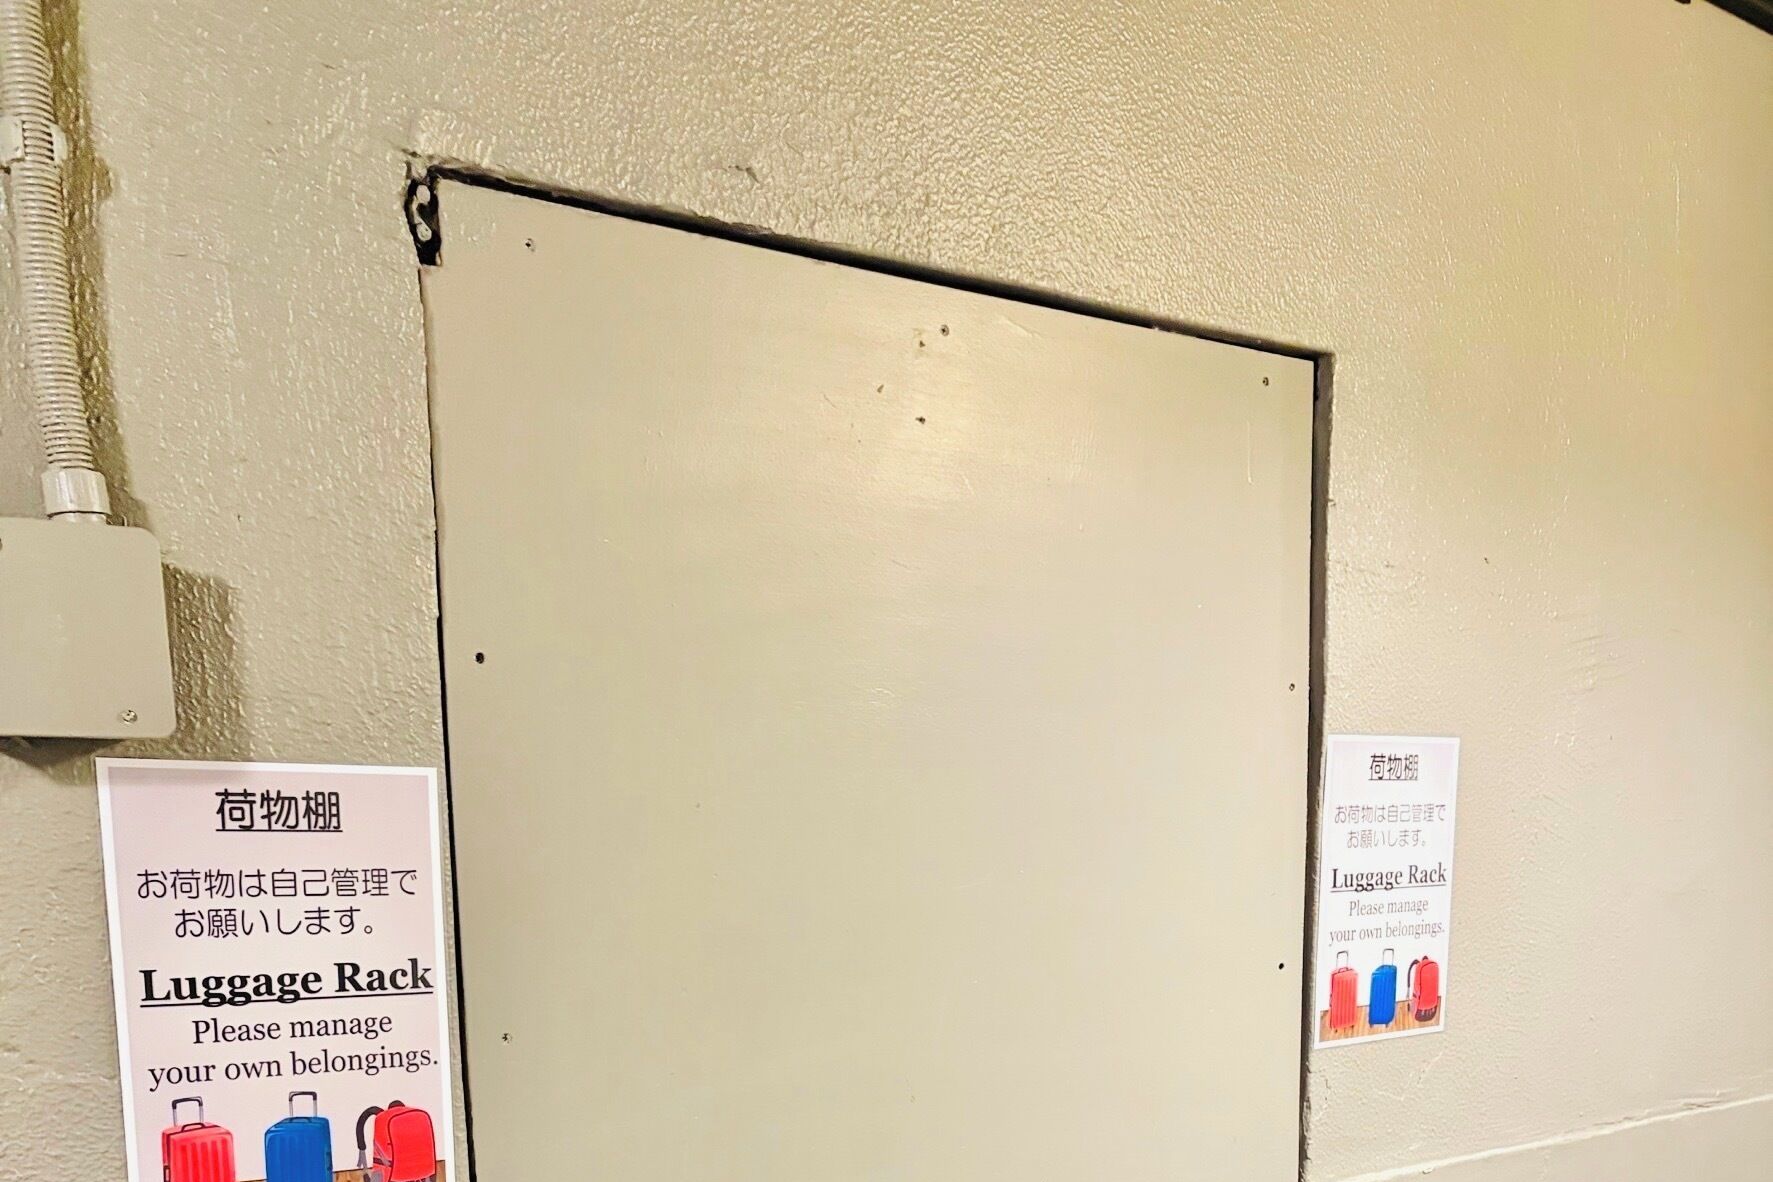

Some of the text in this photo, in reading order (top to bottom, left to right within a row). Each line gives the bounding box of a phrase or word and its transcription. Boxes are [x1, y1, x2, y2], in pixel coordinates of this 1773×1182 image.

[1369, 753, 1418, 780] 荷物棚
[215, 789, 340, 831] 荷物棚
[1335, 804, 1445, 824] お荷物は自己管理で
[1347, 829, 1426, 848] お願いします。
[137, 868, 418, 900] お荷物は自己管理で
[1331, 862, 1447, 891] Luggage Rack
[1349, 899, 1429, 916] Please manage
[175, 908, 373, 939] お願いします。
[1329, 920, 1445, 946] your own belongings.
[140, 959, 433, 1007] Luggage Rack
[192, 1015, 392, 1044] Please manage
[148, 1046, 438, 1091] your own belongings.
